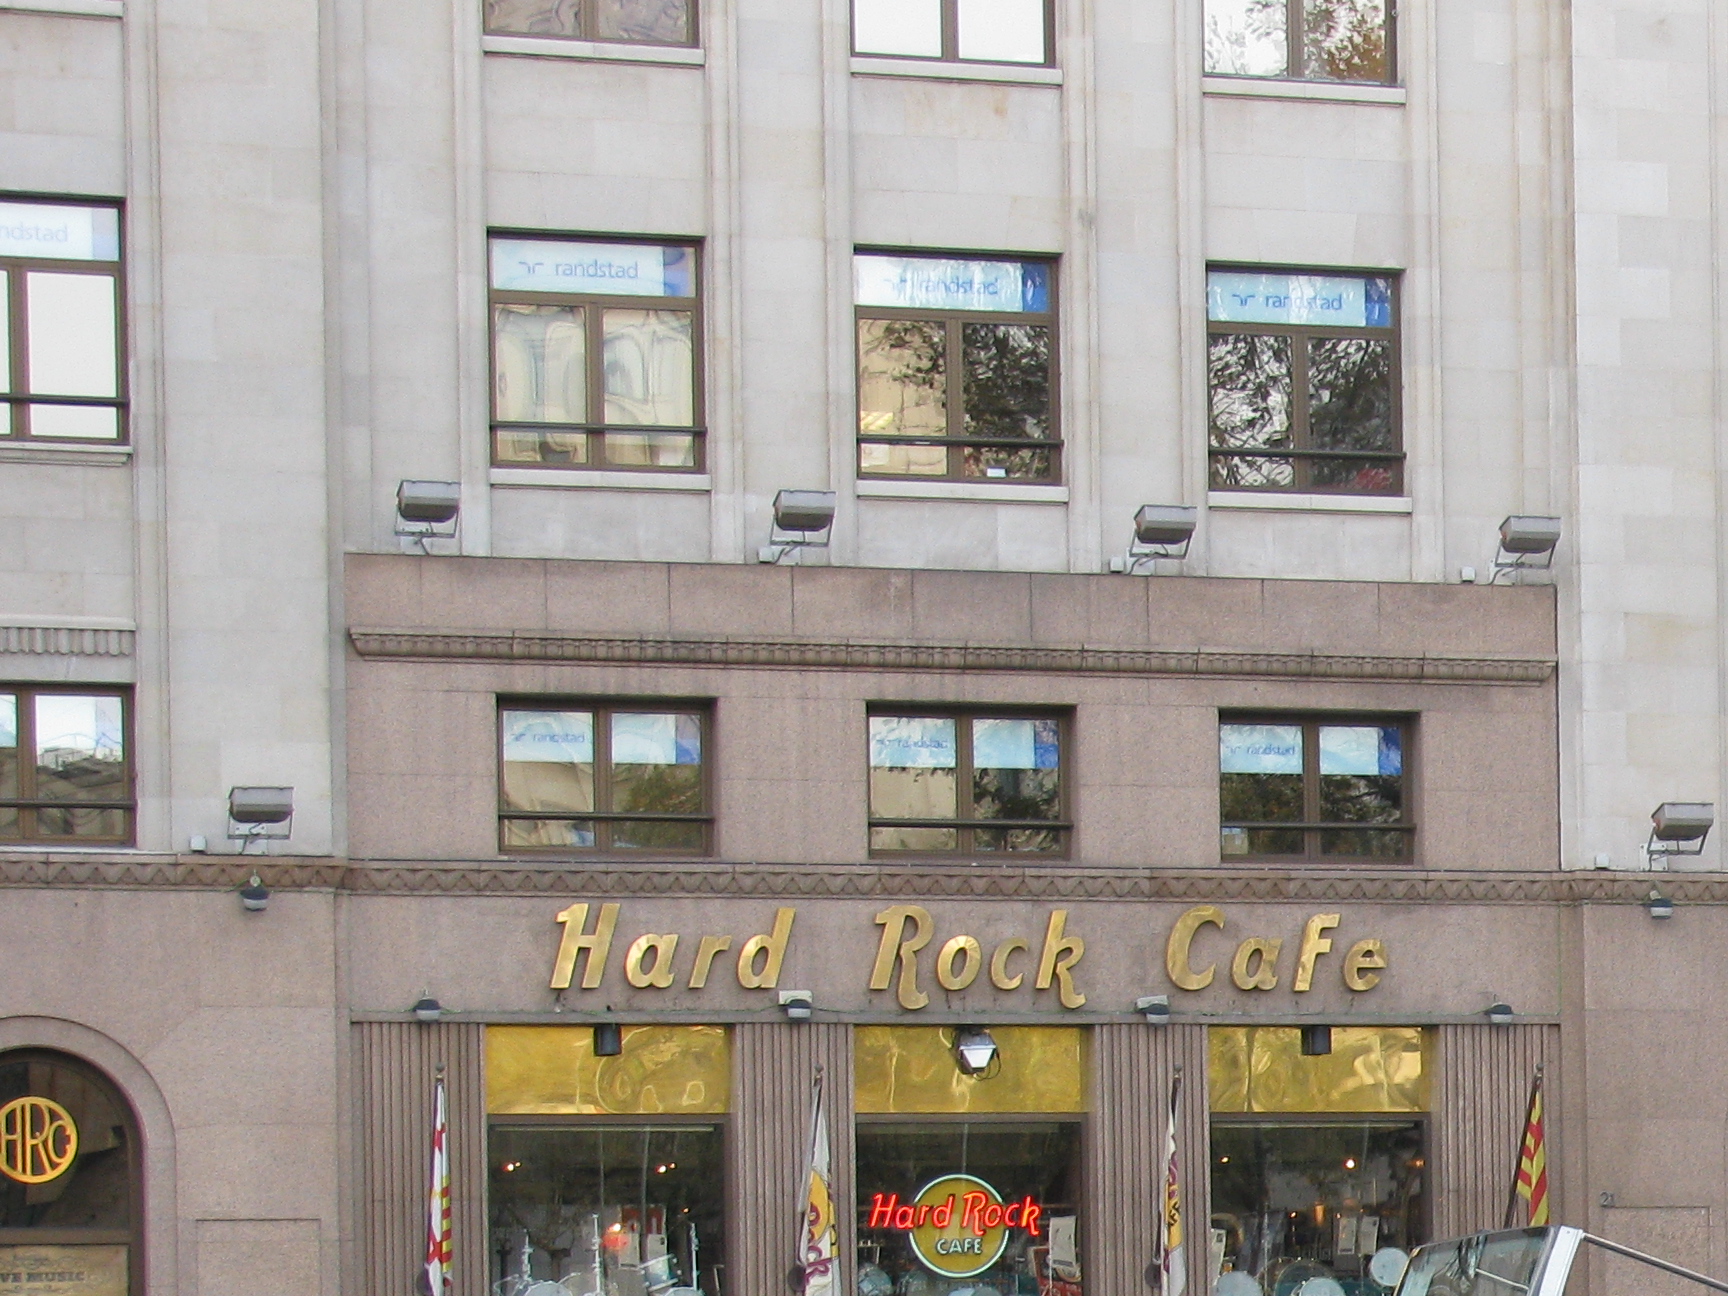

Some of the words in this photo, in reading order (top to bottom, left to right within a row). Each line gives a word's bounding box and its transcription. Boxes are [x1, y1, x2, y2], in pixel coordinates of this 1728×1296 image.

[555, 258, 640, 279] randstad
[550, 903, 797, 989] Hard
[869, 904, 1086, 1010] Rock
[869, 1192, 955, 1230] Hard
[961, 1190, 1042, 1237] Rock
[936, 1237, 983, 1255] CAFE
[26, 1272, 85, 1282] MUSIC
